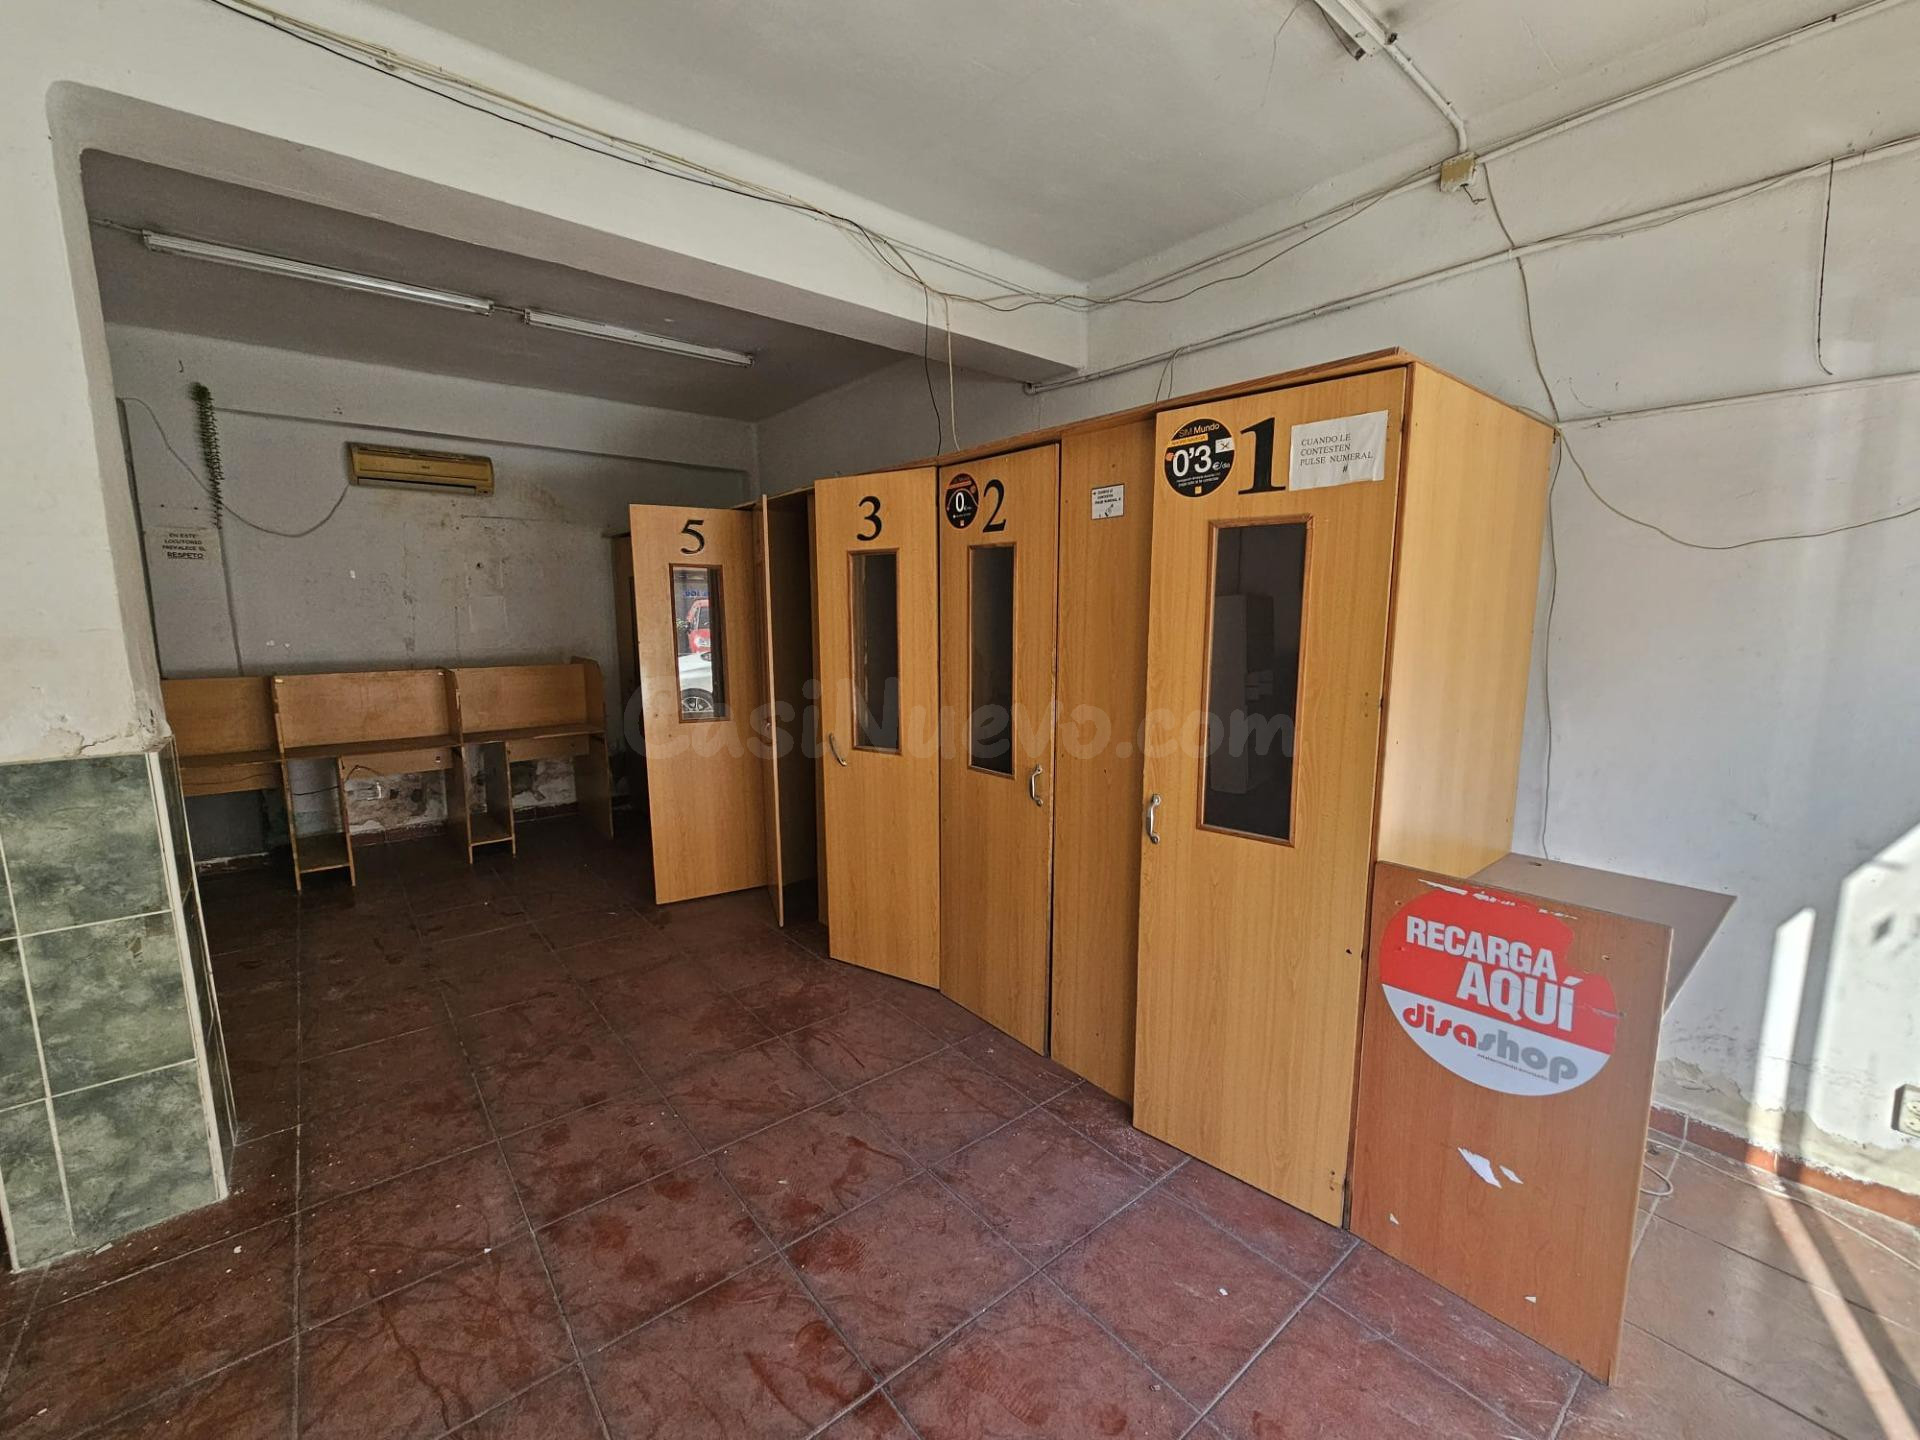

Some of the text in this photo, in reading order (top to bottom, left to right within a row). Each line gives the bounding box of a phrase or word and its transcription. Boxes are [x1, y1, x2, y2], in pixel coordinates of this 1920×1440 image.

[1193, 423, 1220, 434] Mundo
[1301, 432, 1352, 446] CUANDO LE
[1238, 417, 1286, 495] 1
[1299, 450, 1374, 467] PULSE NUMERAL
[1300, 443, 1351, 457] CONTESTEN
[856, 495, 882, 542] 3
[955, 492, 965, 513] 0
[982, 479, 1007, 533] 2
[680, 519, 705, 555] 5
[167, 551, 204, 560] RESPETO
[1406, 915, 1557, 982] RECARGA
[1456, 961, 1584, 1032] AQUÍ
[1402, 1003, 1578, 1084] disashop
